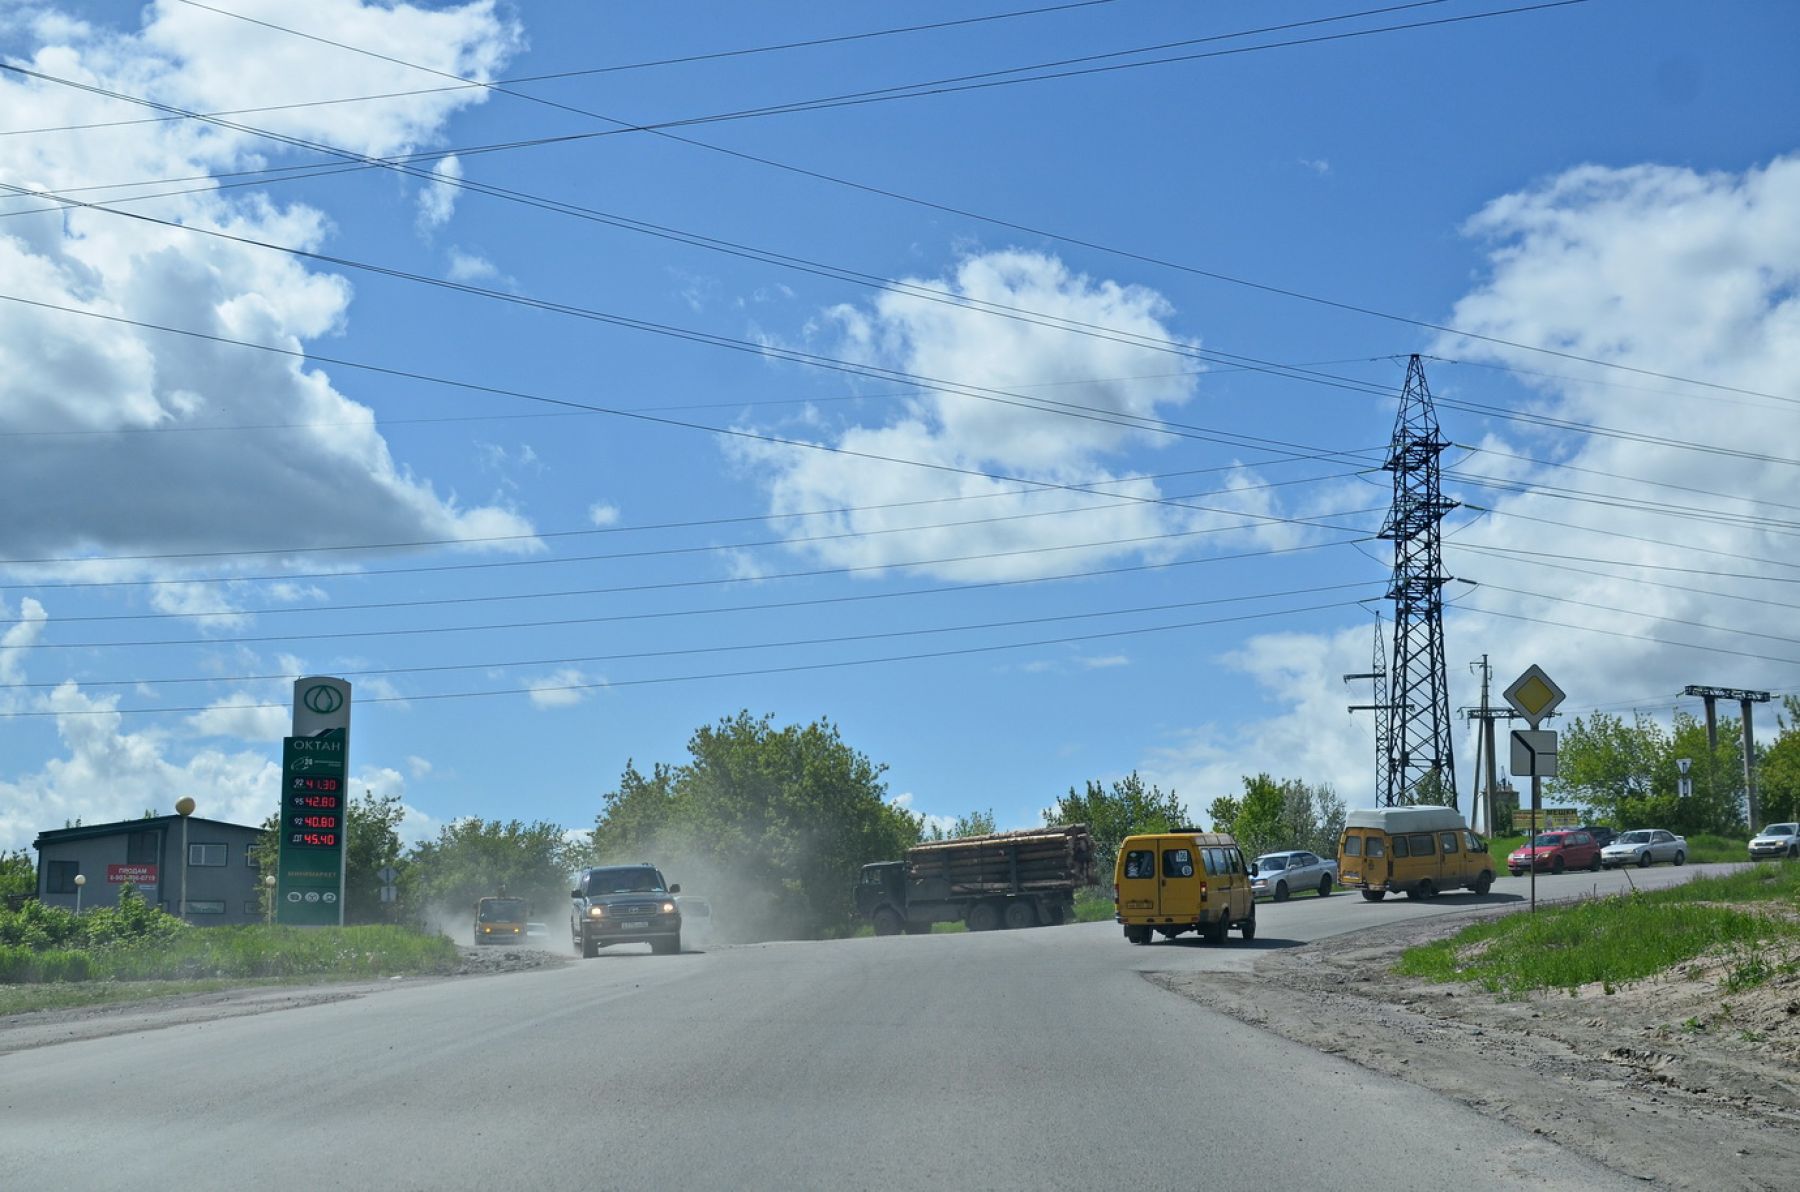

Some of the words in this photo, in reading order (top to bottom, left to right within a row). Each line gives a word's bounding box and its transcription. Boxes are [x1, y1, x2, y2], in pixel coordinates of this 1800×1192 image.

[294, 740, 340, 751] ОКТАН
[305, 779, 336, 790] 41.30
[294, 797, 304, 806] 95
[304, 796, 336, 808] 42.80
[294, 817, 304, 825] 92
[304, 816, 335, 828] 40.80
[292, 834, 303, 843] ДТ
[303, 834, 335, 845] 45.40
